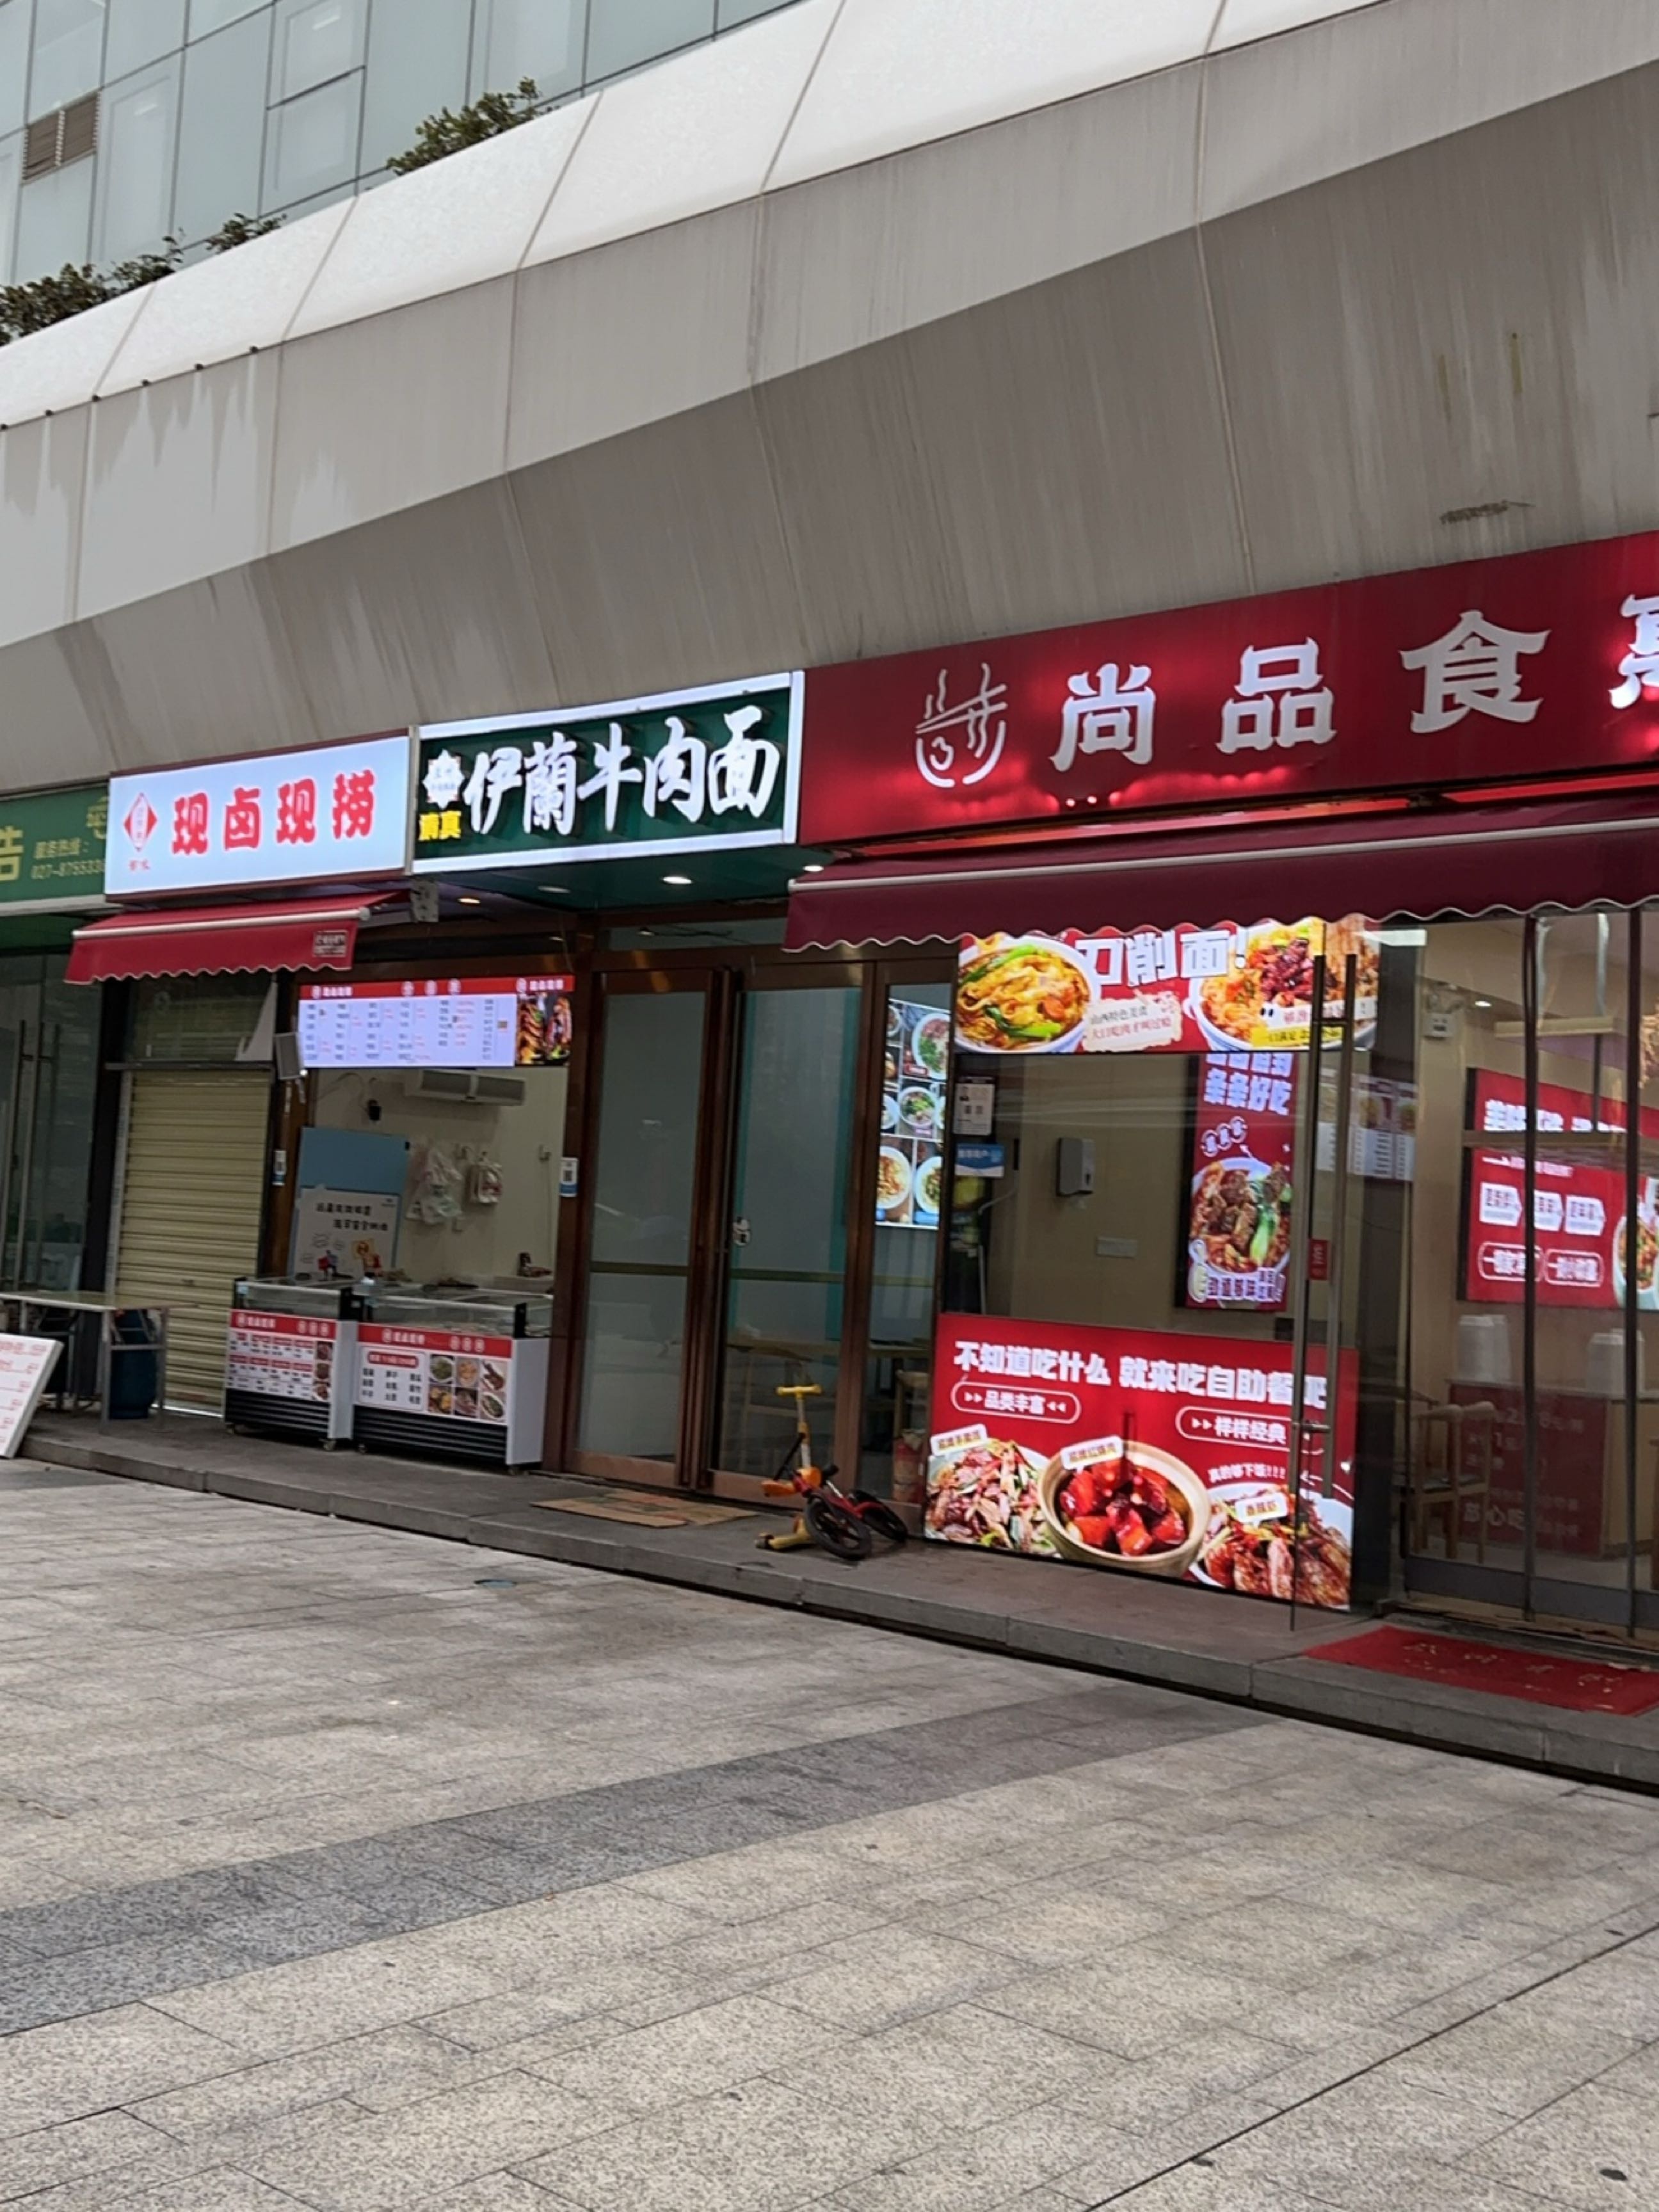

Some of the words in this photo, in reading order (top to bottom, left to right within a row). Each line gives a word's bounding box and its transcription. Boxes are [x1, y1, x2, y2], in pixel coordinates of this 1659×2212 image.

[463, 705, 780, 836] 伊蘭牛肉面
[172, 769, 376, 856] 现卤现捞
[1203, 1067, 1293, 1116] 条条好吃
[954, 1340, 1111, 1386] 不知道吃什么
[984, 1389, 1046, 1415] 品类丰富
